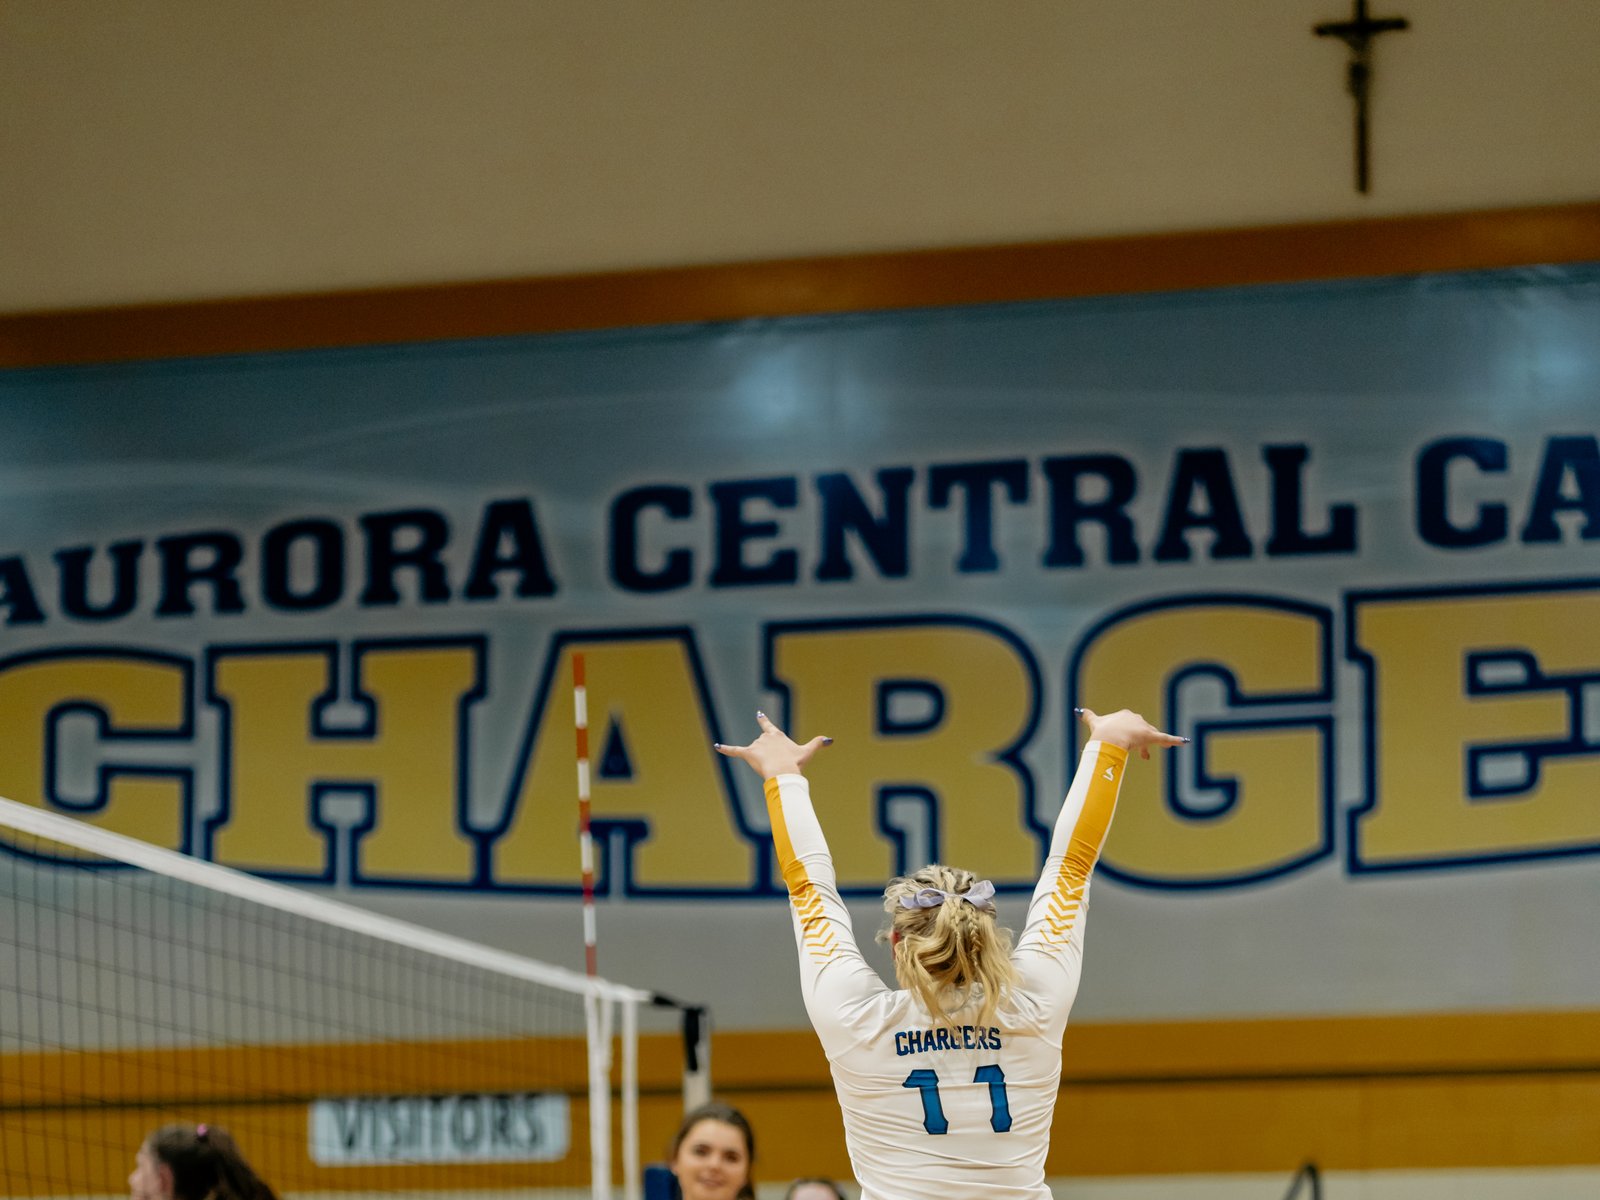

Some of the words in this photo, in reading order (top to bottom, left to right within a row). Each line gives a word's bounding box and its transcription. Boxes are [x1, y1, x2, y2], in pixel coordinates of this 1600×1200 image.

[0, 498, 558, 626] AURORA
[608, 444, 1358, 593] CENTRAL
[1416, 435, 1600, 549] CA
[0, 579, 1600, 898] CHARGE
[332, 1093, 546, 1152] VISITORS
[902, 1064, 1013, 1135] 11
